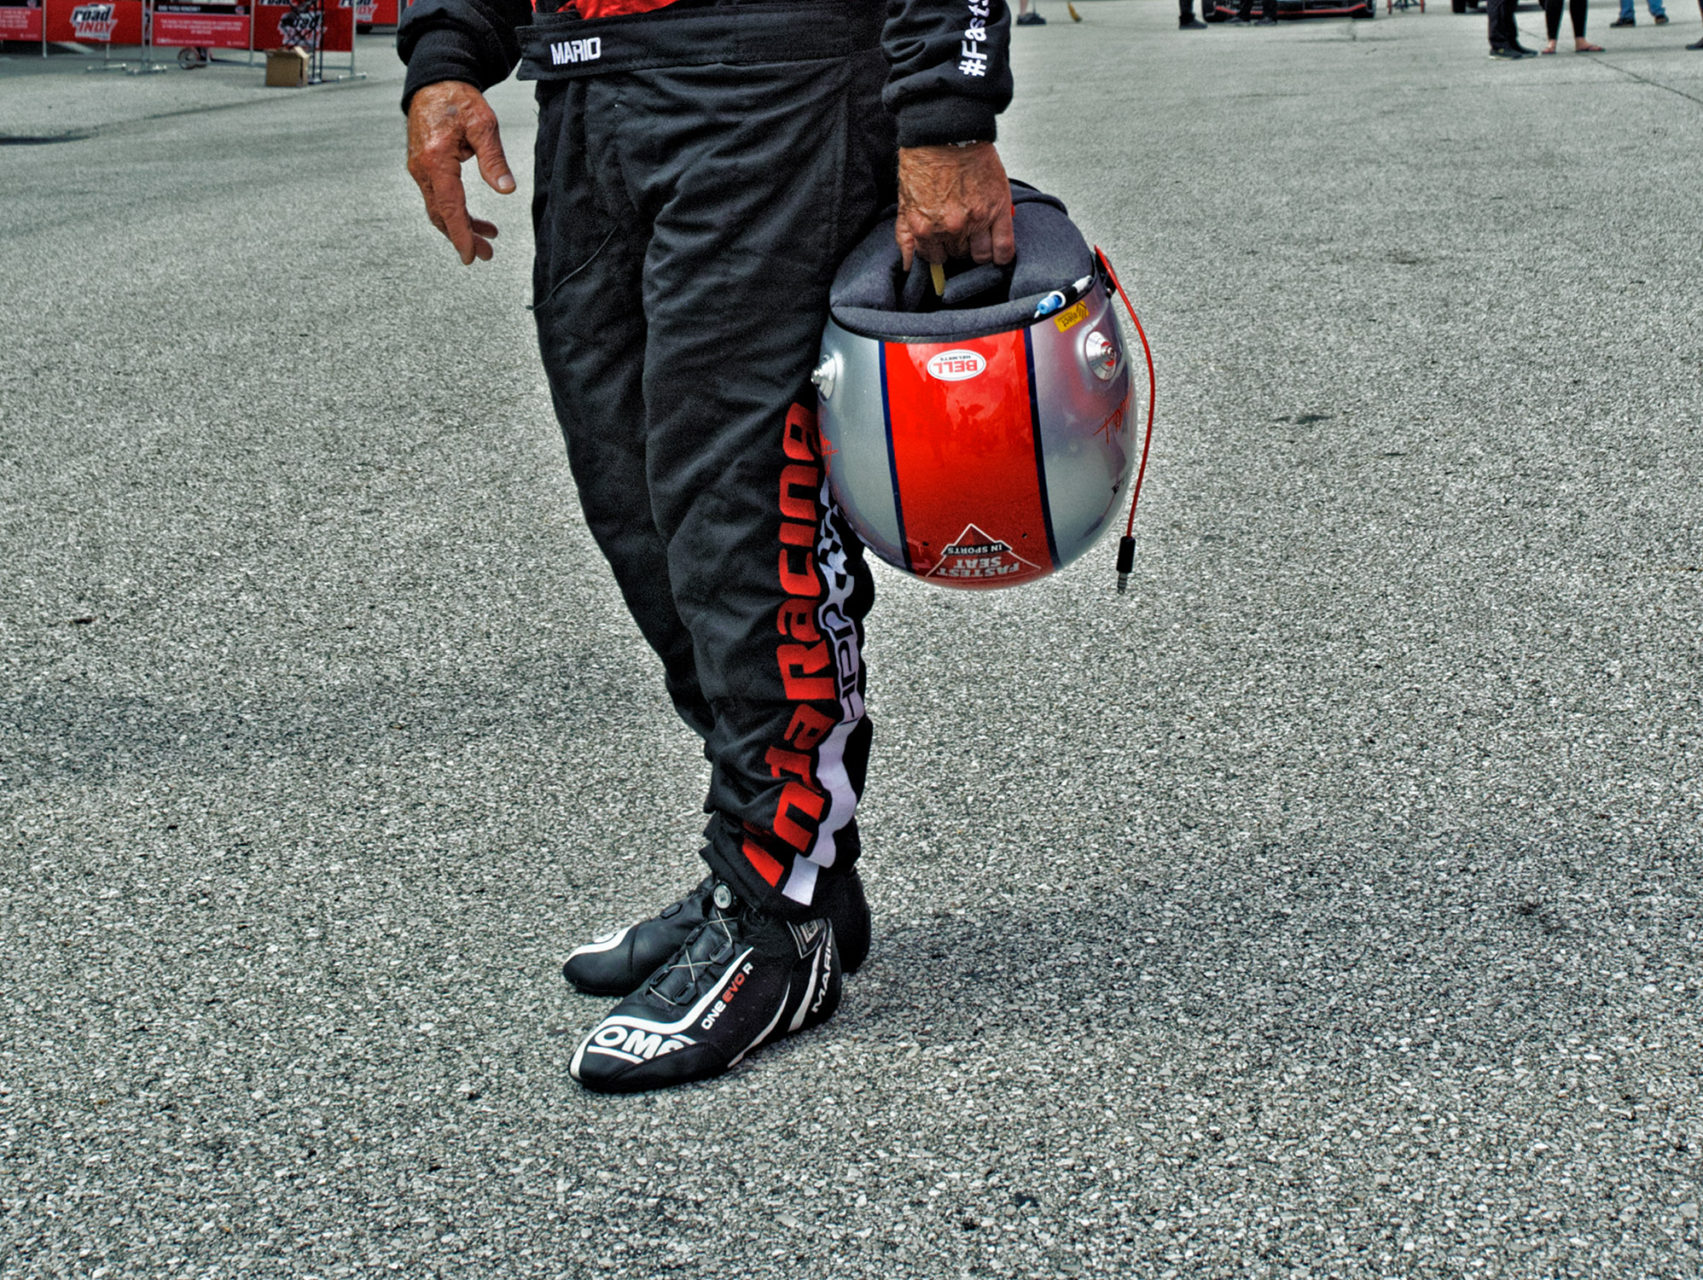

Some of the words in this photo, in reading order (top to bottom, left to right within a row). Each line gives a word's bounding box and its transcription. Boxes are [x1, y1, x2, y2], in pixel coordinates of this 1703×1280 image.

[73, 6, 112, 22] road
[79, 21, 113, 34] INDY
[550, 36, 602, 65] MARIO
[932, 360, 979, 375] BELL
[947, 546, 989, 555] SPORTS
[990, 544, 1003, 552] IN
[937, 562, 1020, 577] FASTEST
[956, 556, 1002, 570] SEAT
[701, 1000, 727, 1031] ONE
[722, 972, 746, 1003] EVO
[742, 962, 755, 976] R
